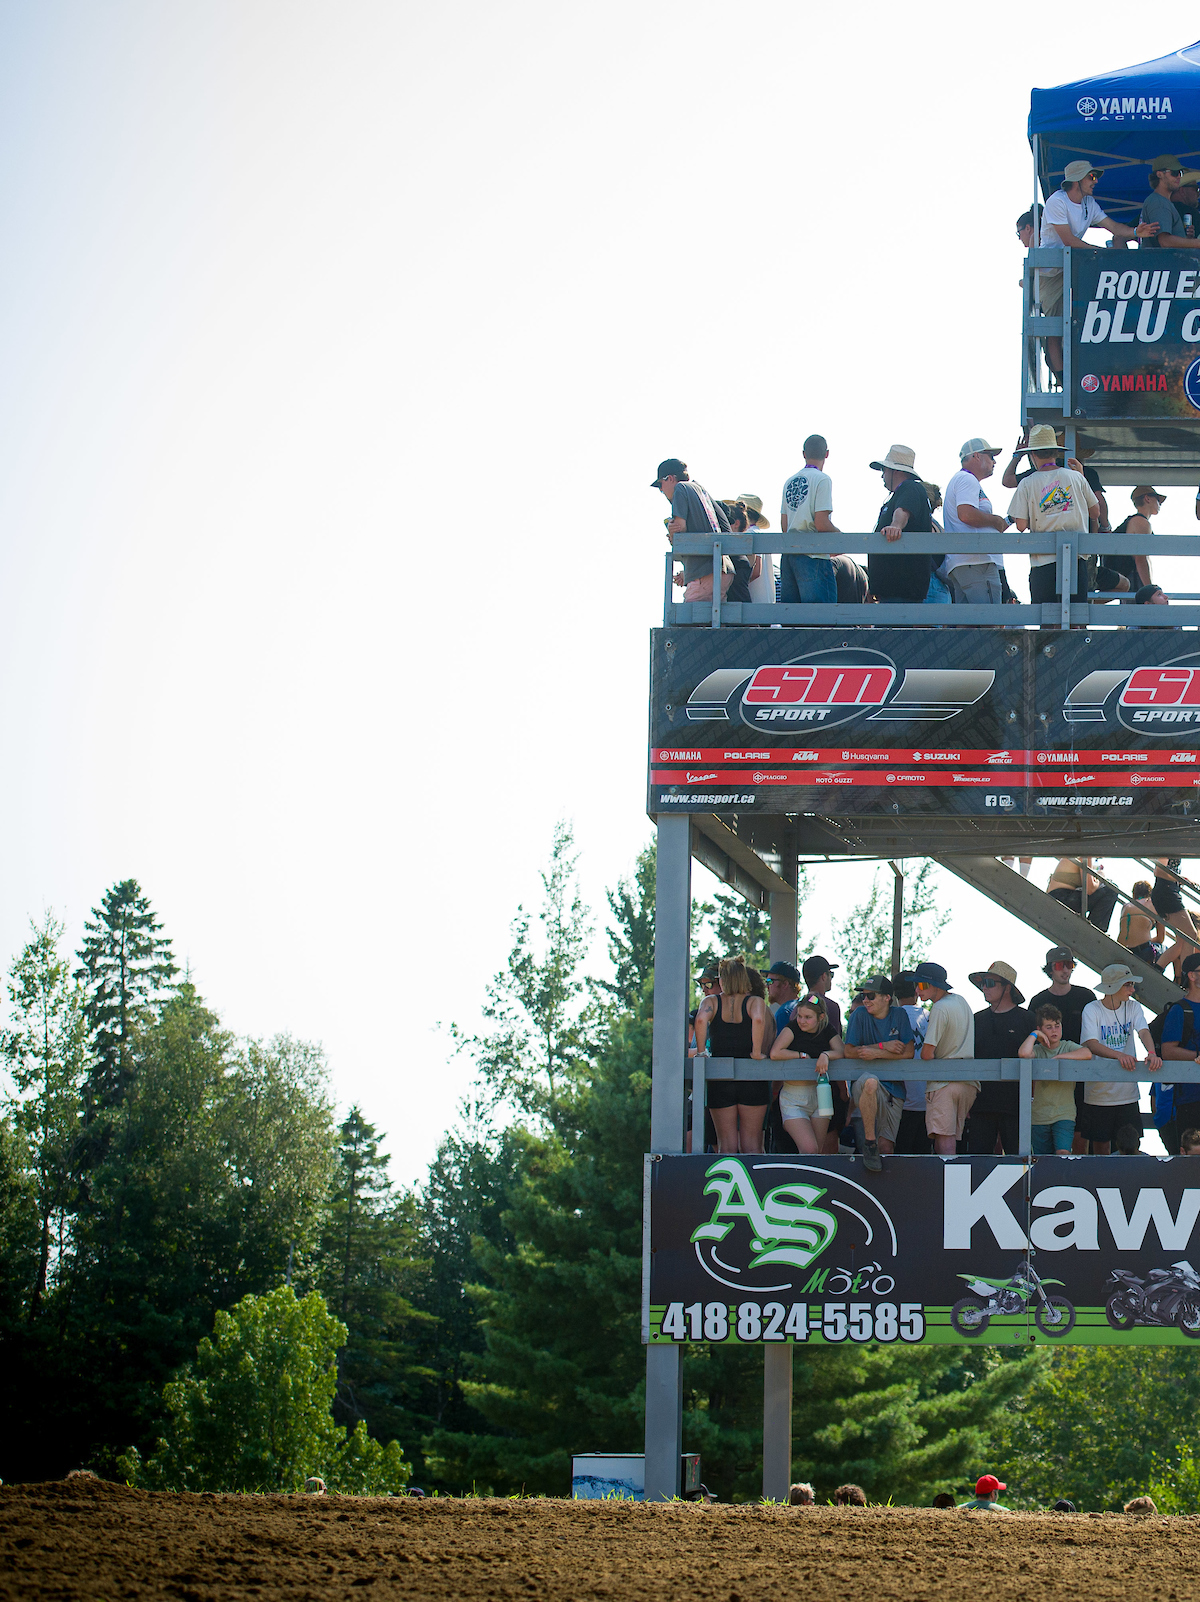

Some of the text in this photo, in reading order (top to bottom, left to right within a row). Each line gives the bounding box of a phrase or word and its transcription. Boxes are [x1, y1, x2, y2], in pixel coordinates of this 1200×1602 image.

[1099, 97, 1172, 114] YAMAHA
[1080, 300, 1171, 344] bLU
[1101, 374, 1168, 392] YAMAHA
[755, 709, 831, 721] SPORT
[669, 751, 701, 761] YAMAHA
[724, 752, 771, 760] POLARIS
[792, 750, 819, 761] KTM
[850, 752, 889, 761] Husqvarna
[1046, 753, 1079, 762] YAMAHA
[1101, 754, 1148, 762] POLARIS
[1169, 752, 1197, 762] KTM
[686, 772, 718, 784] Vespa
[1064, 774, 1096, 785] Vespa
[660, 794, 755, 805] www.smsport.ca
[1039, 795, 1134, 807] www.smsport.ca
[690, 1156, 838, 1270] AS
[661, 1301, 925, 1342] 418 824-5585
